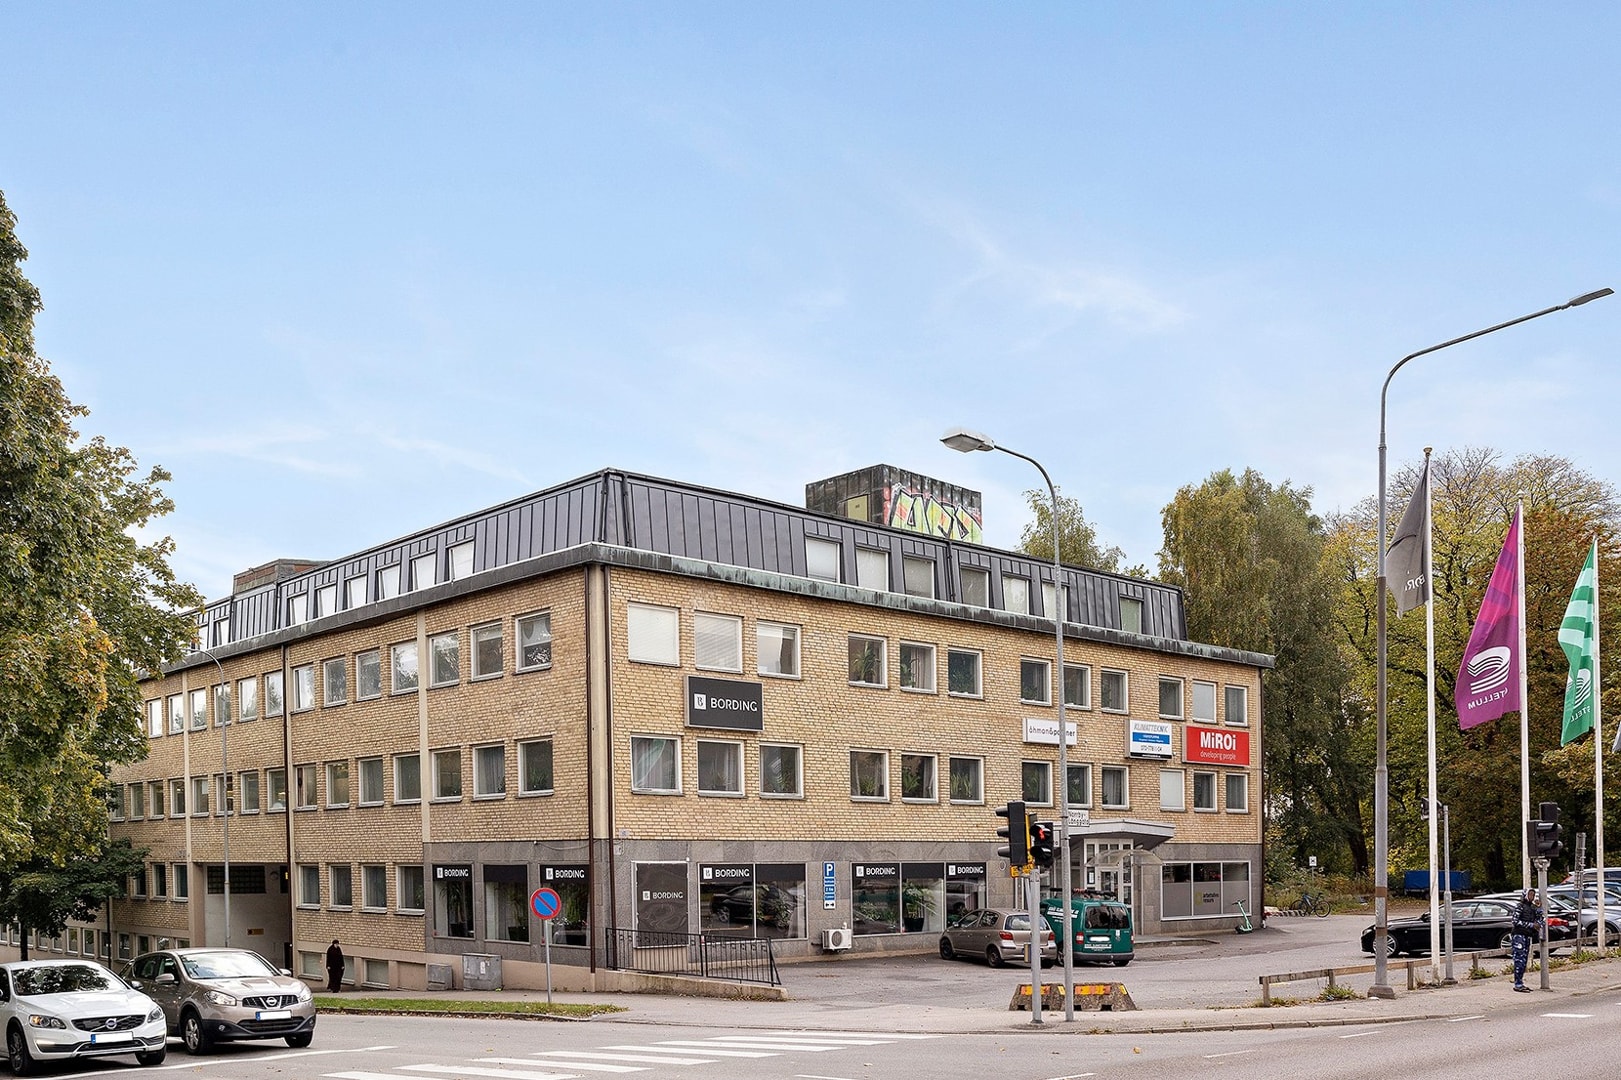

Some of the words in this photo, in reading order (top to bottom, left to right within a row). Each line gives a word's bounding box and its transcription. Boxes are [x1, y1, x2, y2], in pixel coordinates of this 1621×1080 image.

[710, 697, 758, 712] BORDING
[1200, 731, 1236, 751] MiROi
[444, 868, 469, 877] BORDING
[555, 869, 585, 879] BORDING
[715, 868, 750, 878] BORDING
[865, 867, 896, 876] BORDING
[957, 865, 984, 874] BORDING
[652, 891, 684, 900] BORDING
